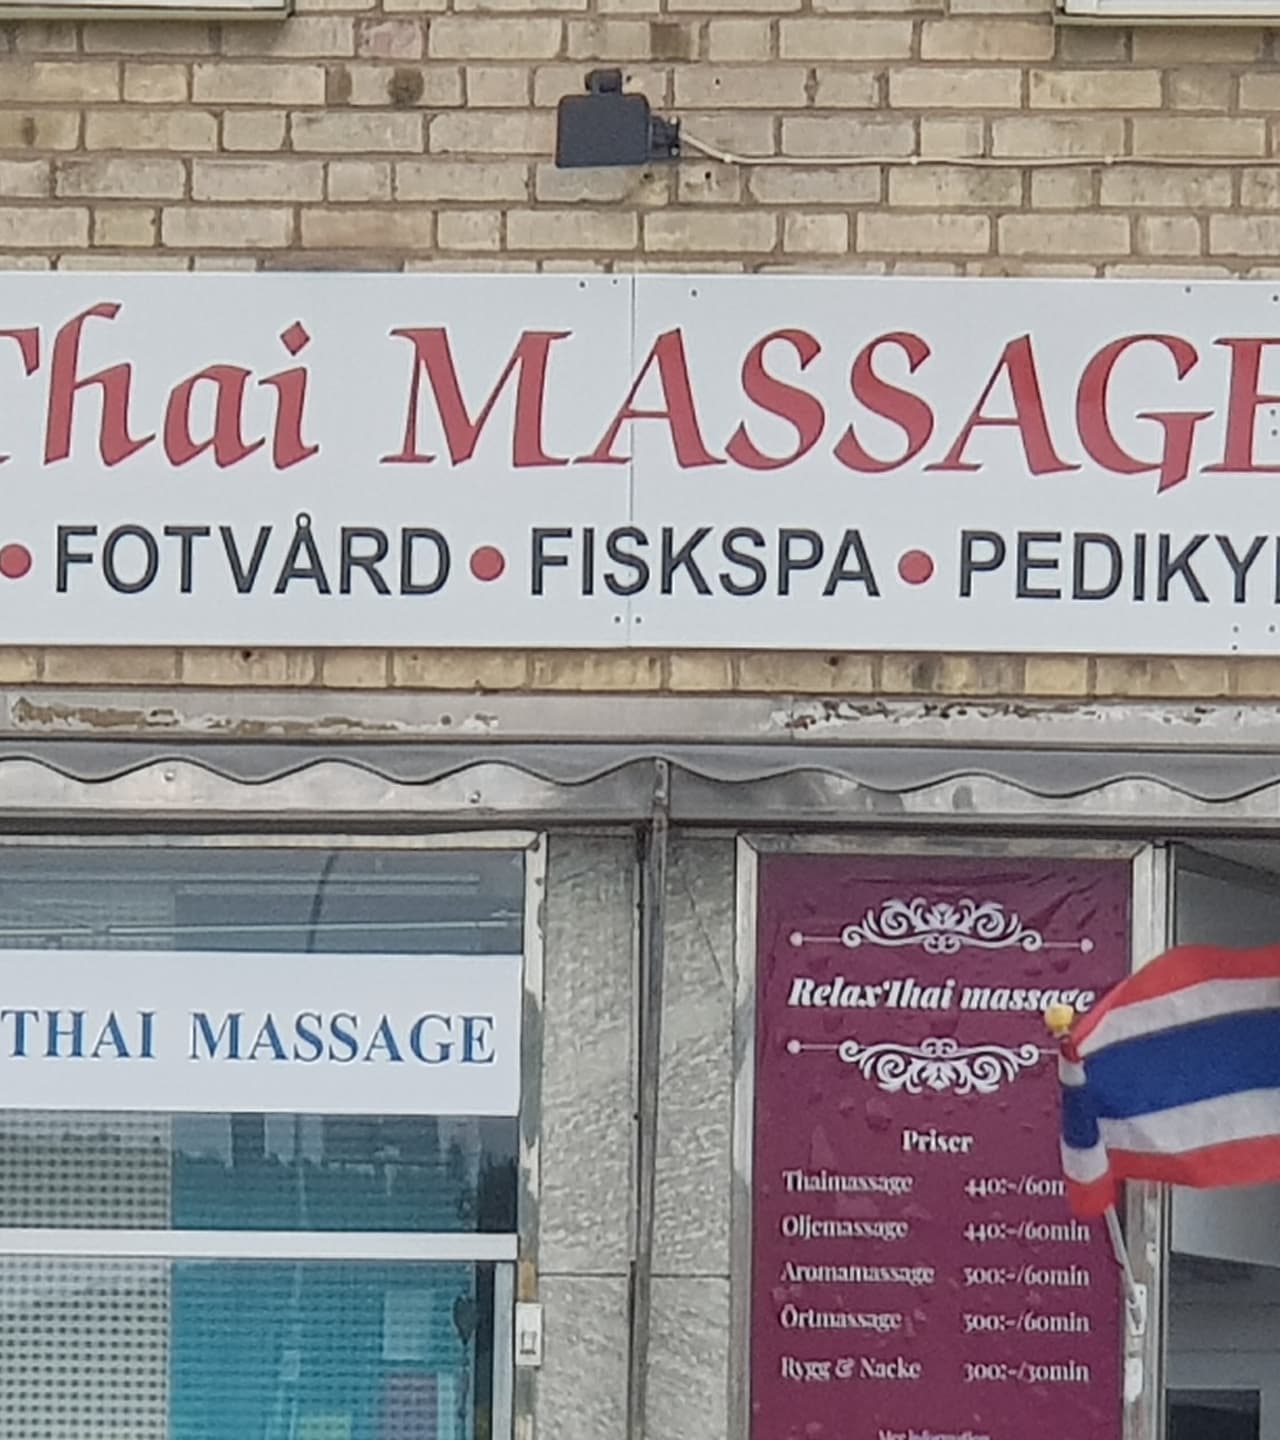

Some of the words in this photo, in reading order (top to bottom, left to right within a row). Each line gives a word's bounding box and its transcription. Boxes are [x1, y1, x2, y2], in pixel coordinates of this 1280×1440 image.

[55, 511, 452, 596] FOTVÅRD
[530, 525, 881, 598] FISKSPA
[189, 1012, 495, 1065] MASSAGE
[903, 1128, 974, 1153] Priser
[782, 1169, 913, 1196] Thaimassage
[782, 1214, 909, 1241] Oljemassage
[780, 1262, 935, 1287] Aromamassage
[780, 1303, 902, 1333] Örtmassage
[781, 1356, 832, 1382] Rygg
[834, 1357, 855, 1379] &
[860, 1356, 922, 1379] Nacke
